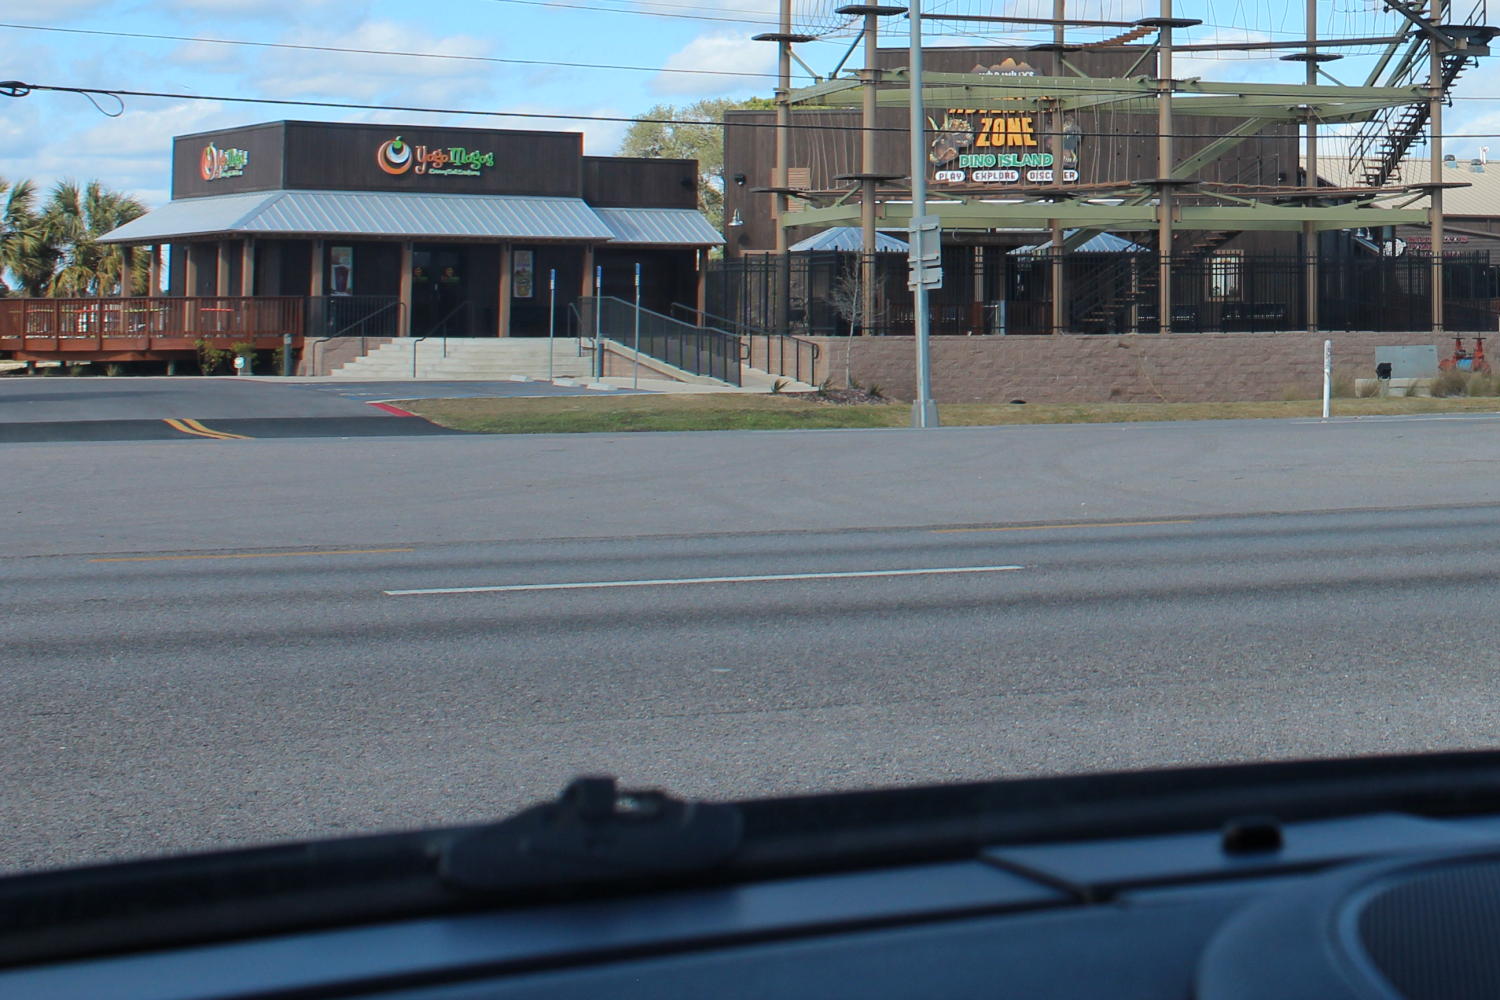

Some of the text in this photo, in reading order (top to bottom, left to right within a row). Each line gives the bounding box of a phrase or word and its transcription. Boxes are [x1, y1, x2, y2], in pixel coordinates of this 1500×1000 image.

[975, 117, 1038, 147] ZONE
[959, 152, 1054, 169] DINO ISLAND
[939, 171, 1075, 181] PLAY EXPLORE DISCER
